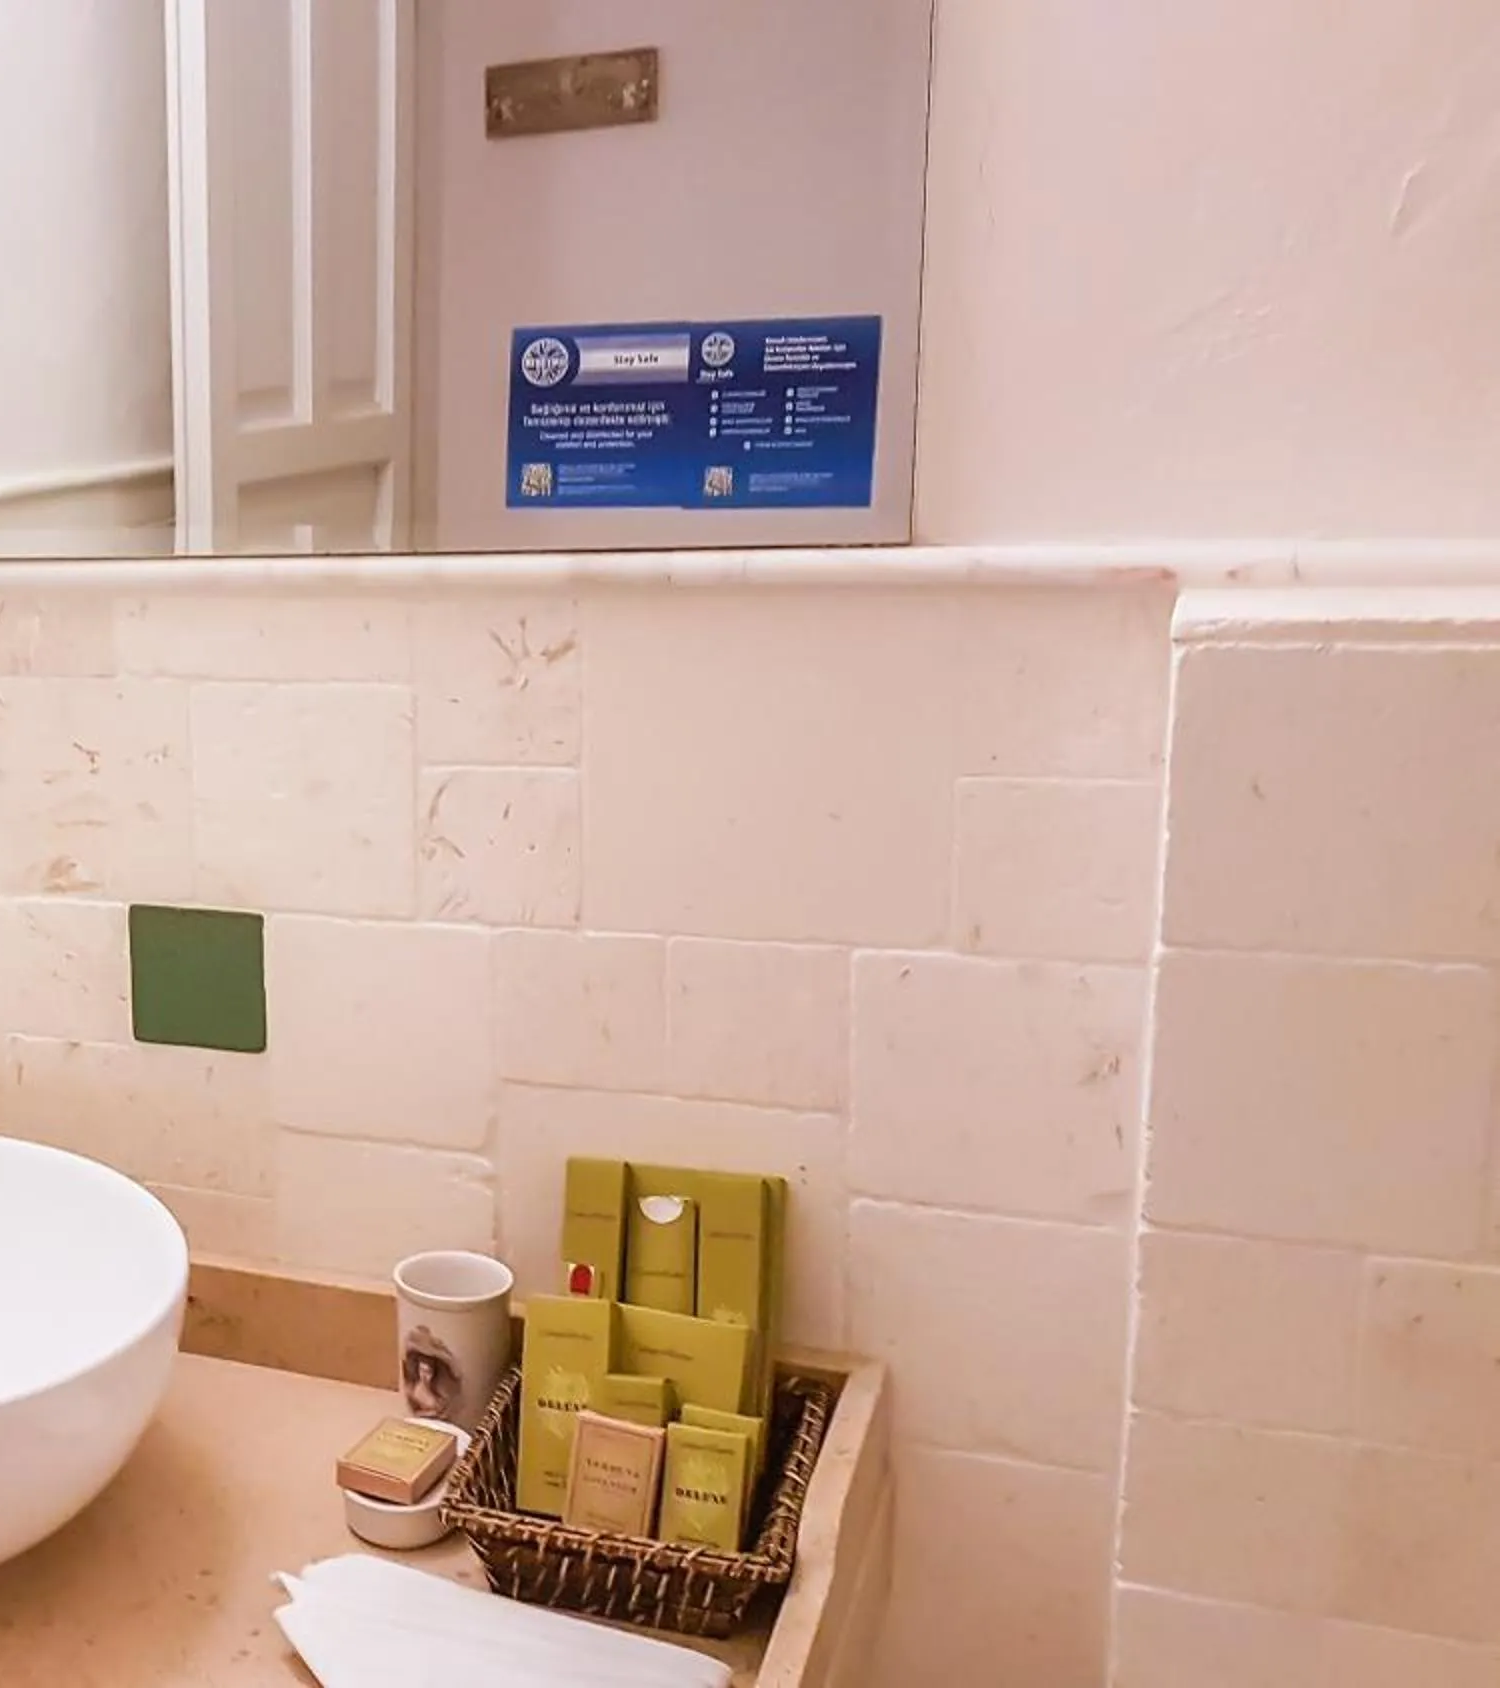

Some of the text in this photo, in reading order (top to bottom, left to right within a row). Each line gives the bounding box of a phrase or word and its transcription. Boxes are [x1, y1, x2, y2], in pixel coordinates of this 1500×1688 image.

[613, 354, 660, 366] Stay Safe
[675, 1486, 728, 1505] DELUXE
